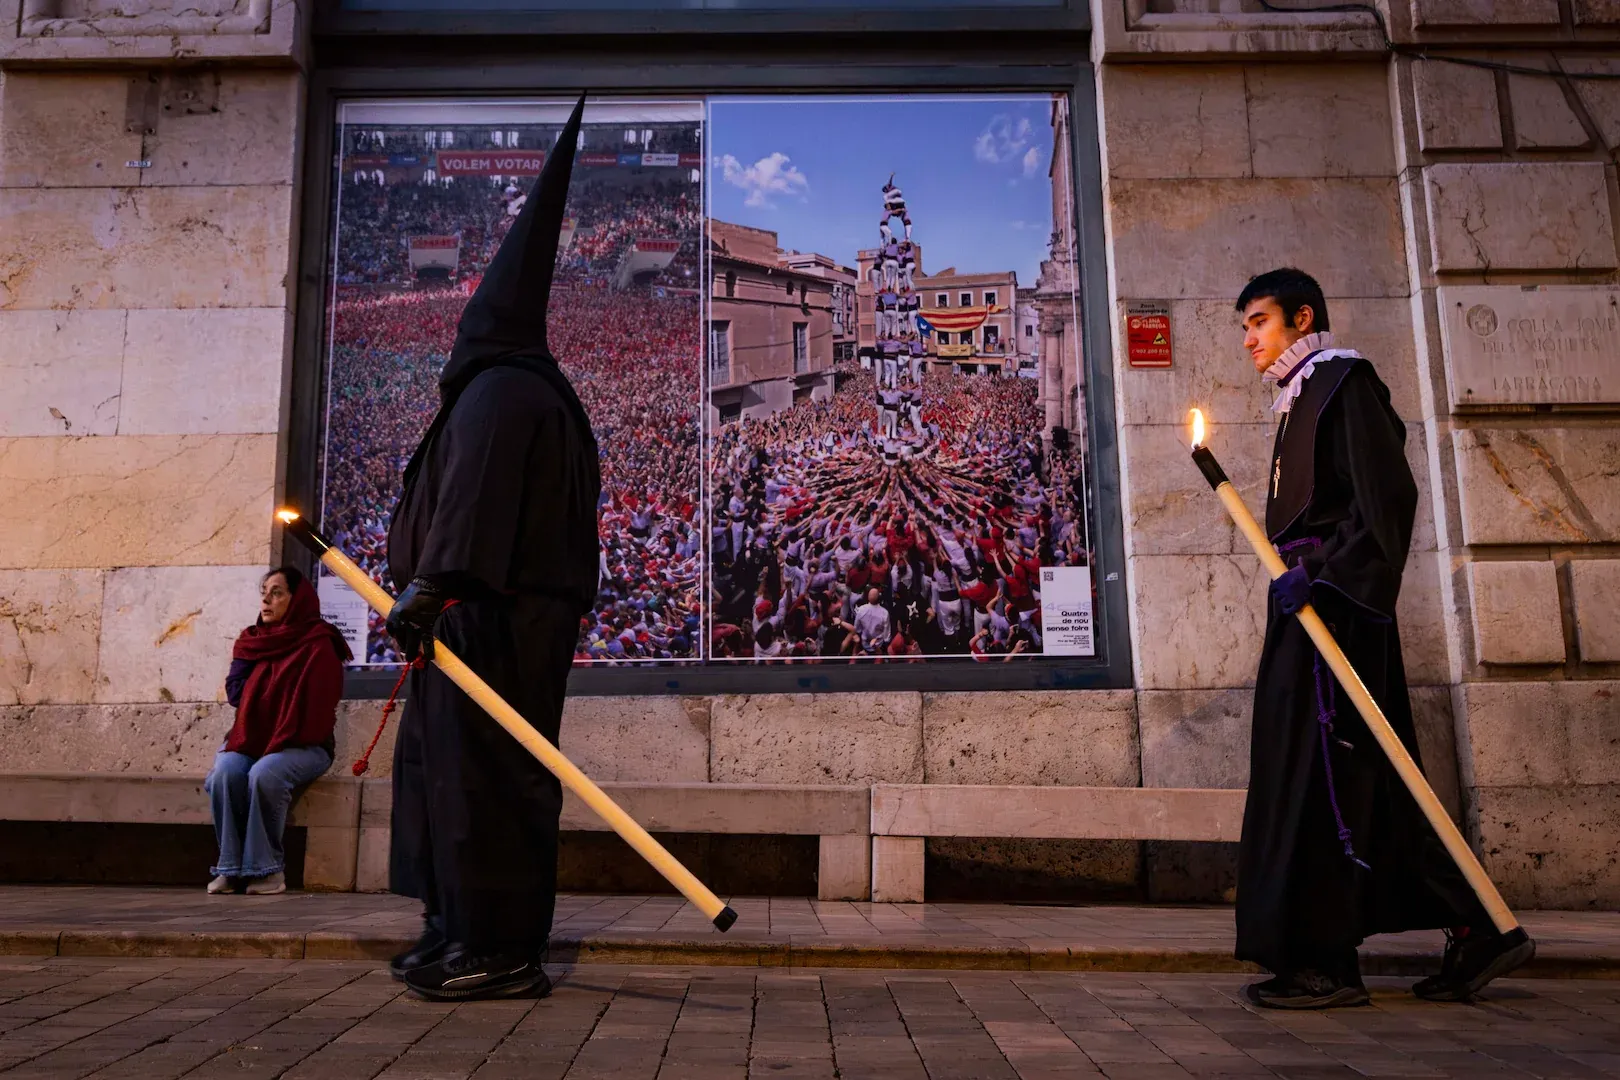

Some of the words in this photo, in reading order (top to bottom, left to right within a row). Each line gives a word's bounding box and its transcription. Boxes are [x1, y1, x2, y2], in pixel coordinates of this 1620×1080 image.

[442, 158, 490, 171] VOLEM
[495, 157, 541, 171] VOTAR
[1507, 318, 1563, 332] COLLA
[1491, 376, 1602, 391] TARRAGONA
